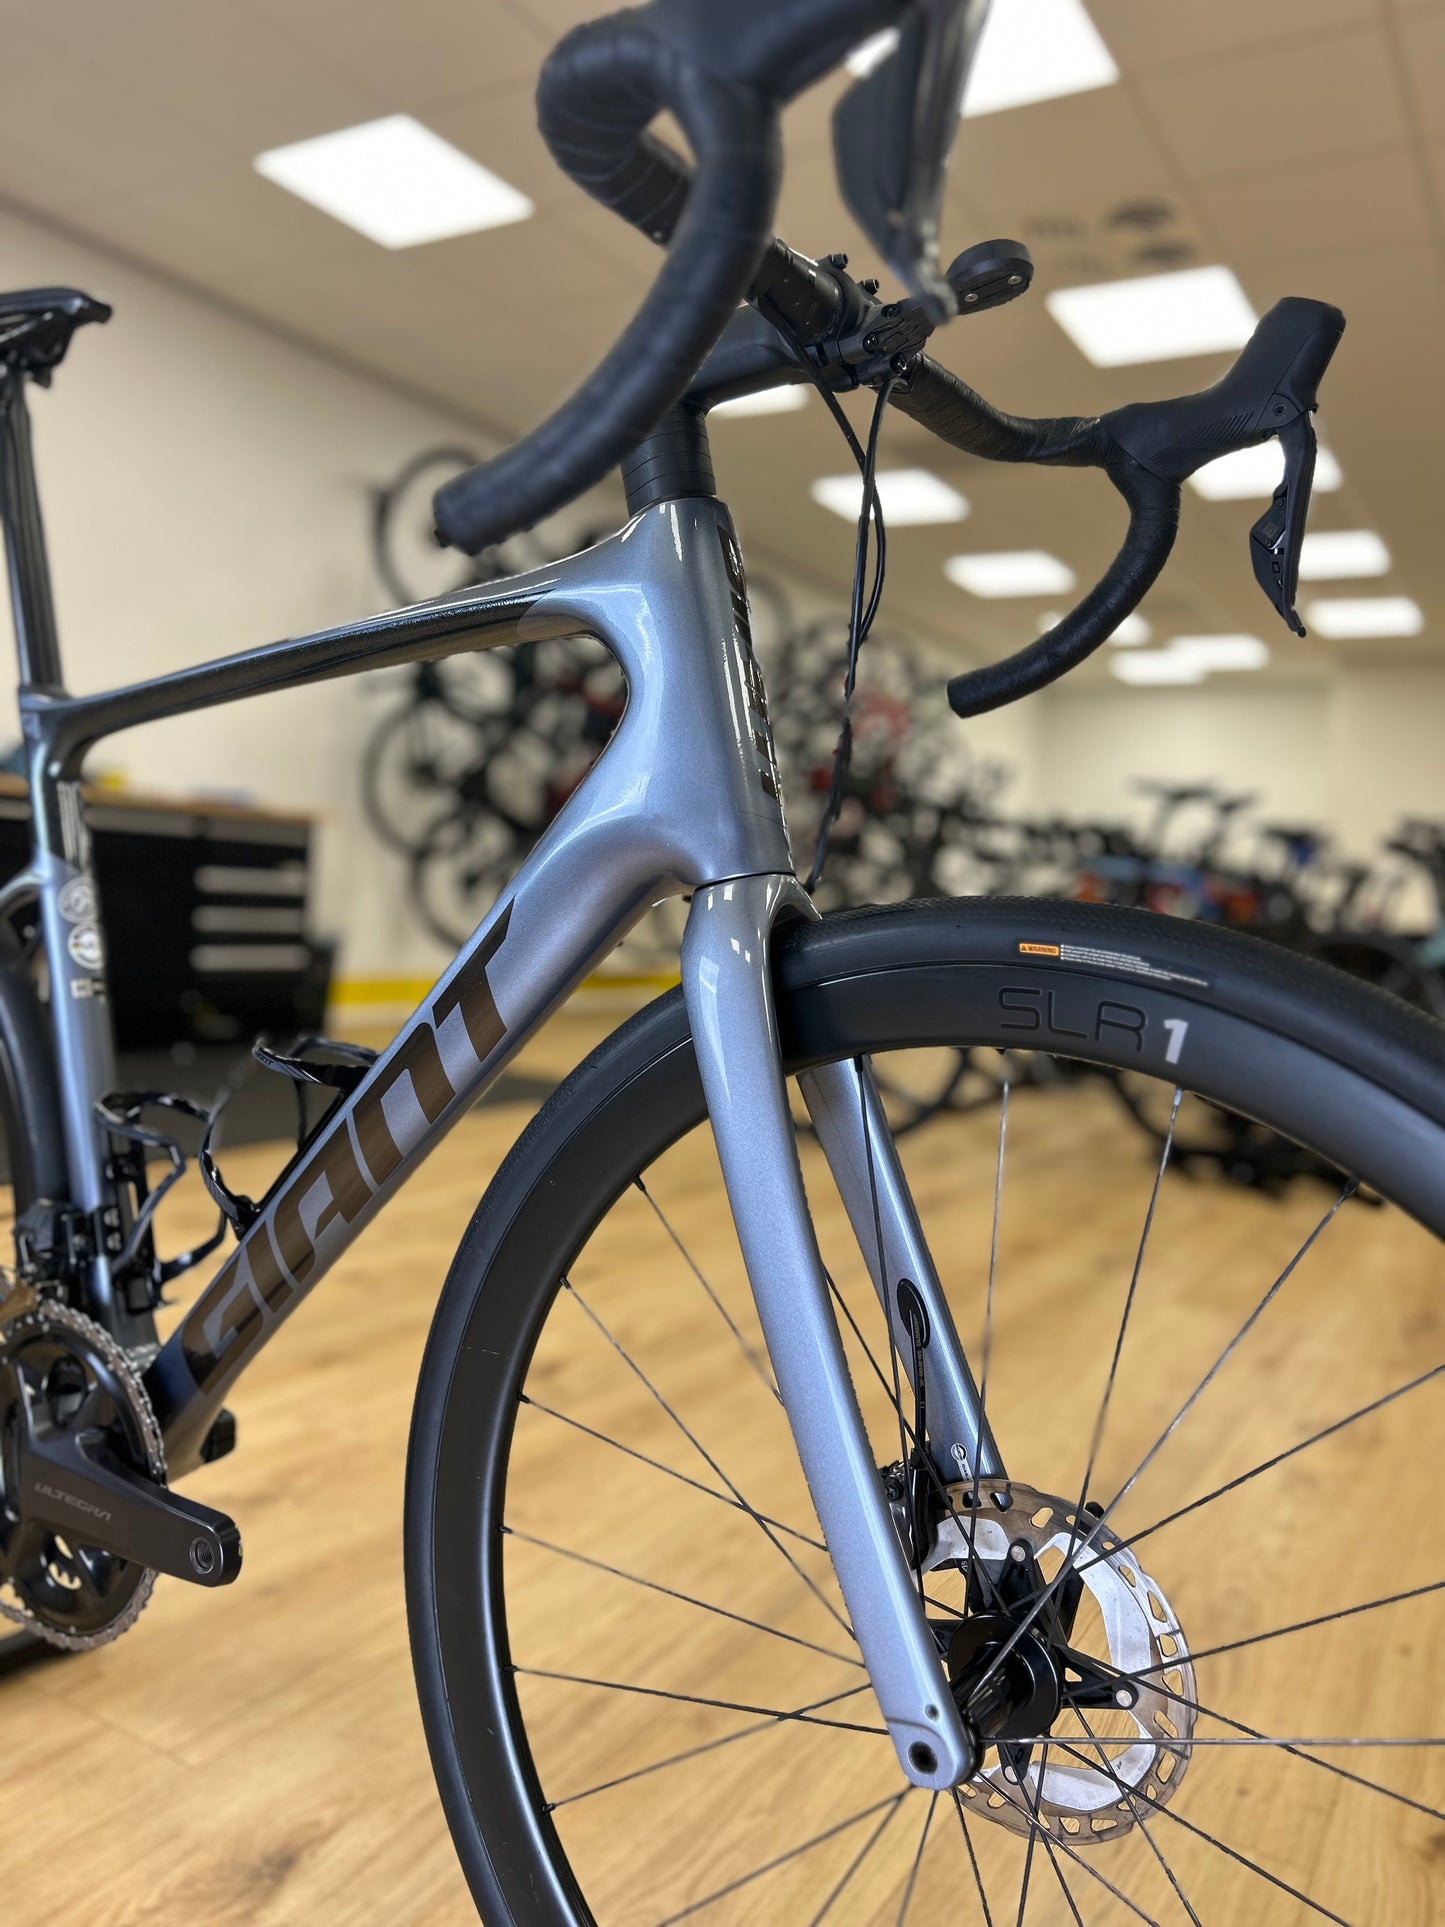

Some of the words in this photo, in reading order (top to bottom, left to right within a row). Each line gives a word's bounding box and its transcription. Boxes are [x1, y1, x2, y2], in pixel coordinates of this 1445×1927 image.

[999, 986, 1147, 1052] SLR
[1163, 1018, 1188, 1064] 1
[181, 895, 515, 1393] GIANT
[34, 1481, 112, 1522] ULTEGRA
